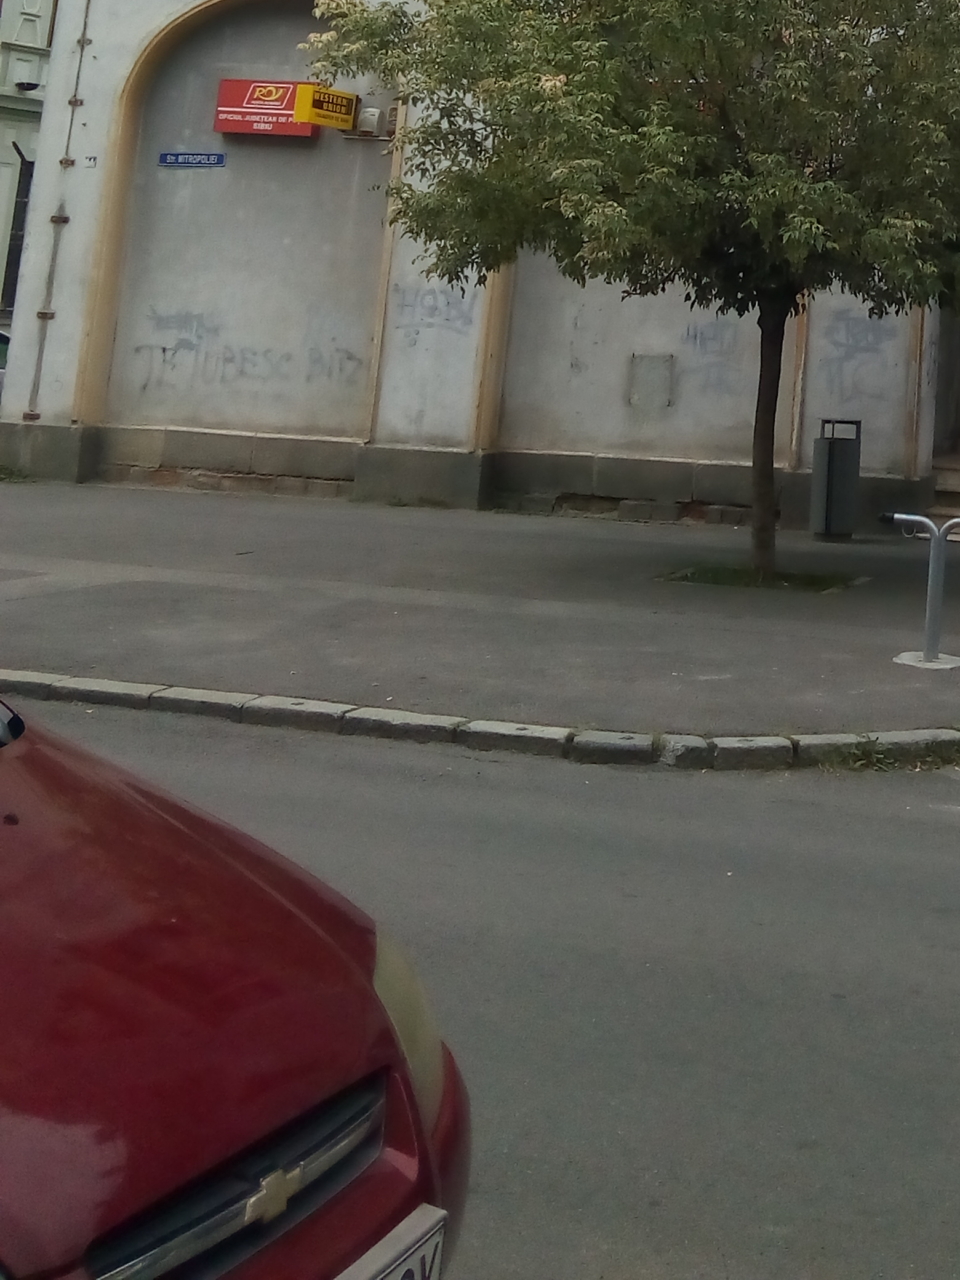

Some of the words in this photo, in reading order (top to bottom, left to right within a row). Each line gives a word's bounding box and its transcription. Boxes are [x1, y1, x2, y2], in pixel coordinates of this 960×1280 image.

[314, 91, 347, 106] WESTERN
[322, 102, 347, 114] UNION
[218, 113, 243, 121] OFICIUL
[253, 122, 273, 130] SIBIU
